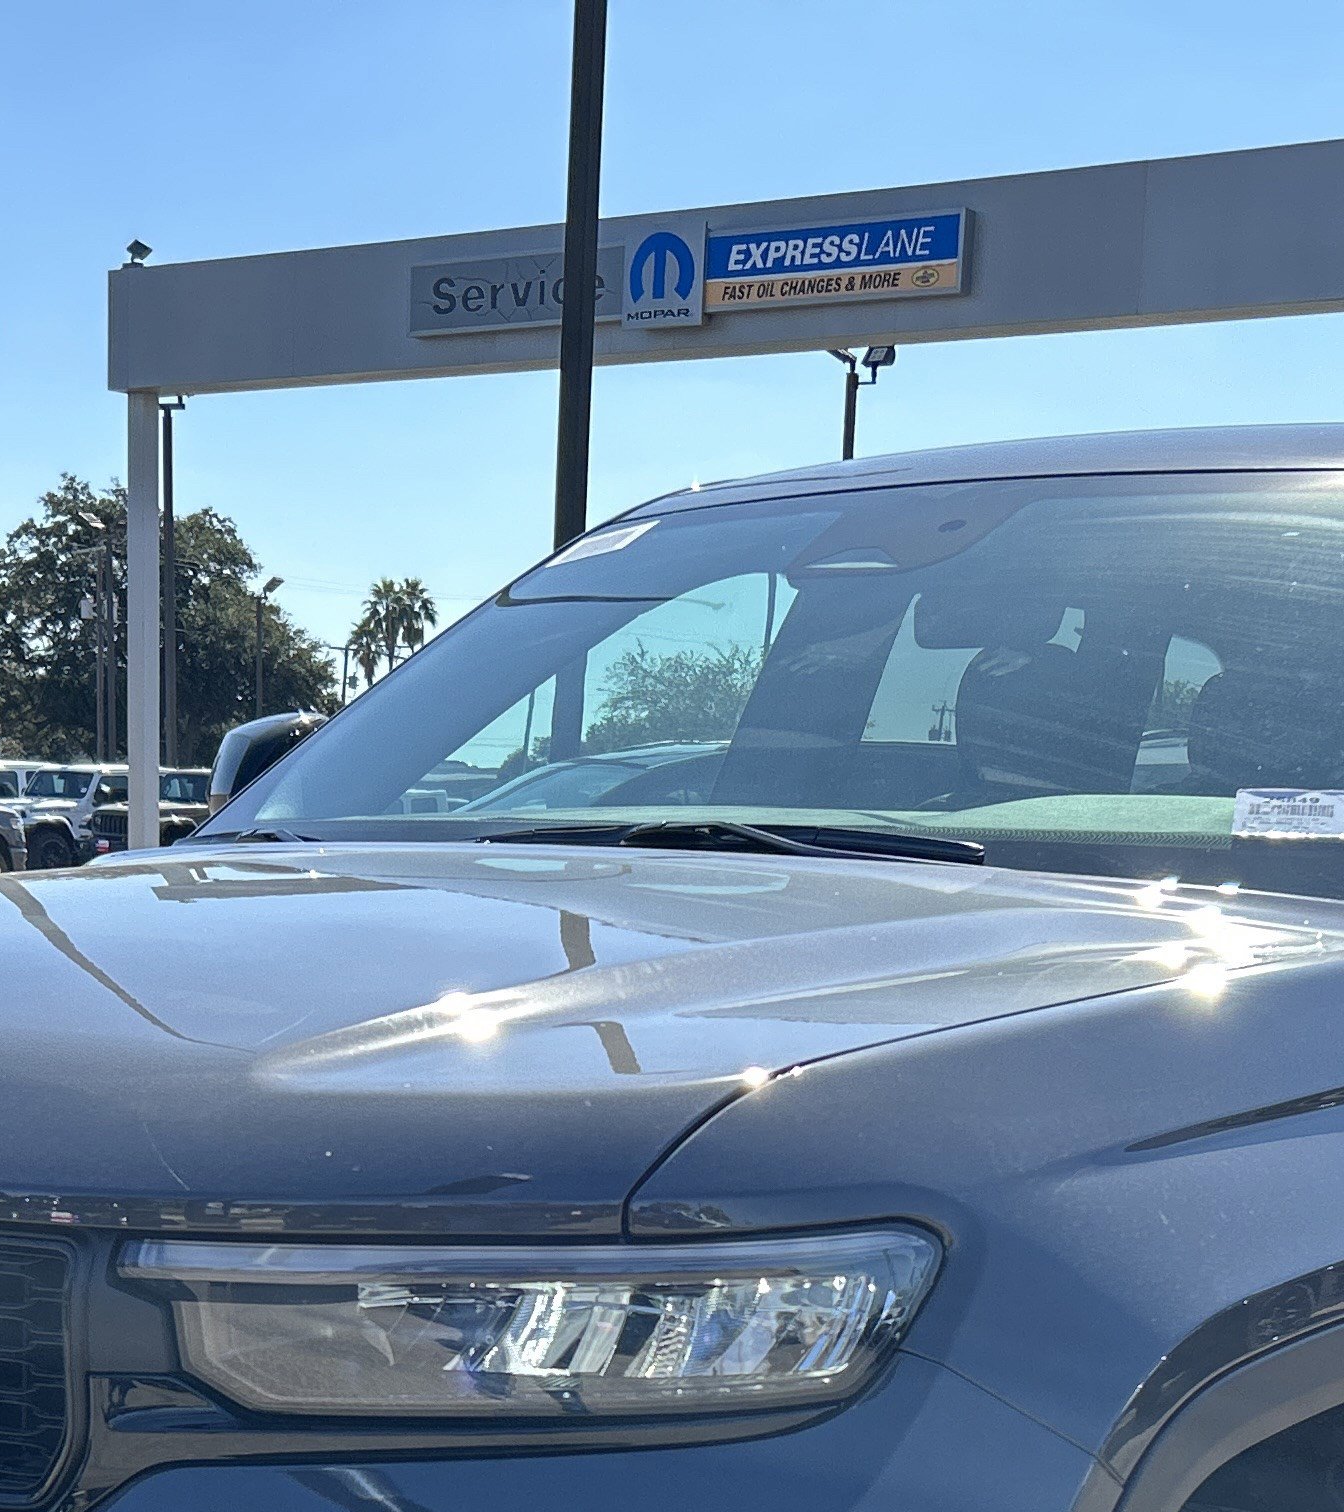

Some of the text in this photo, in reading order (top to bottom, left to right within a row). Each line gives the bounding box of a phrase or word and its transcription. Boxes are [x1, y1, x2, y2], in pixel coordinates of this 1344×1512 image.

[727, 226, 935, 271] EXPRESSLANE
[722, 284, 754, 301] FAST
[757, 283, 776, 299] OIL
[780, 277, 843, 298] CHANGES
[845, 277, 856, 292] &
[859, 272, 902, 290] MORE
[626, 307, 690, 321] MOPAR
